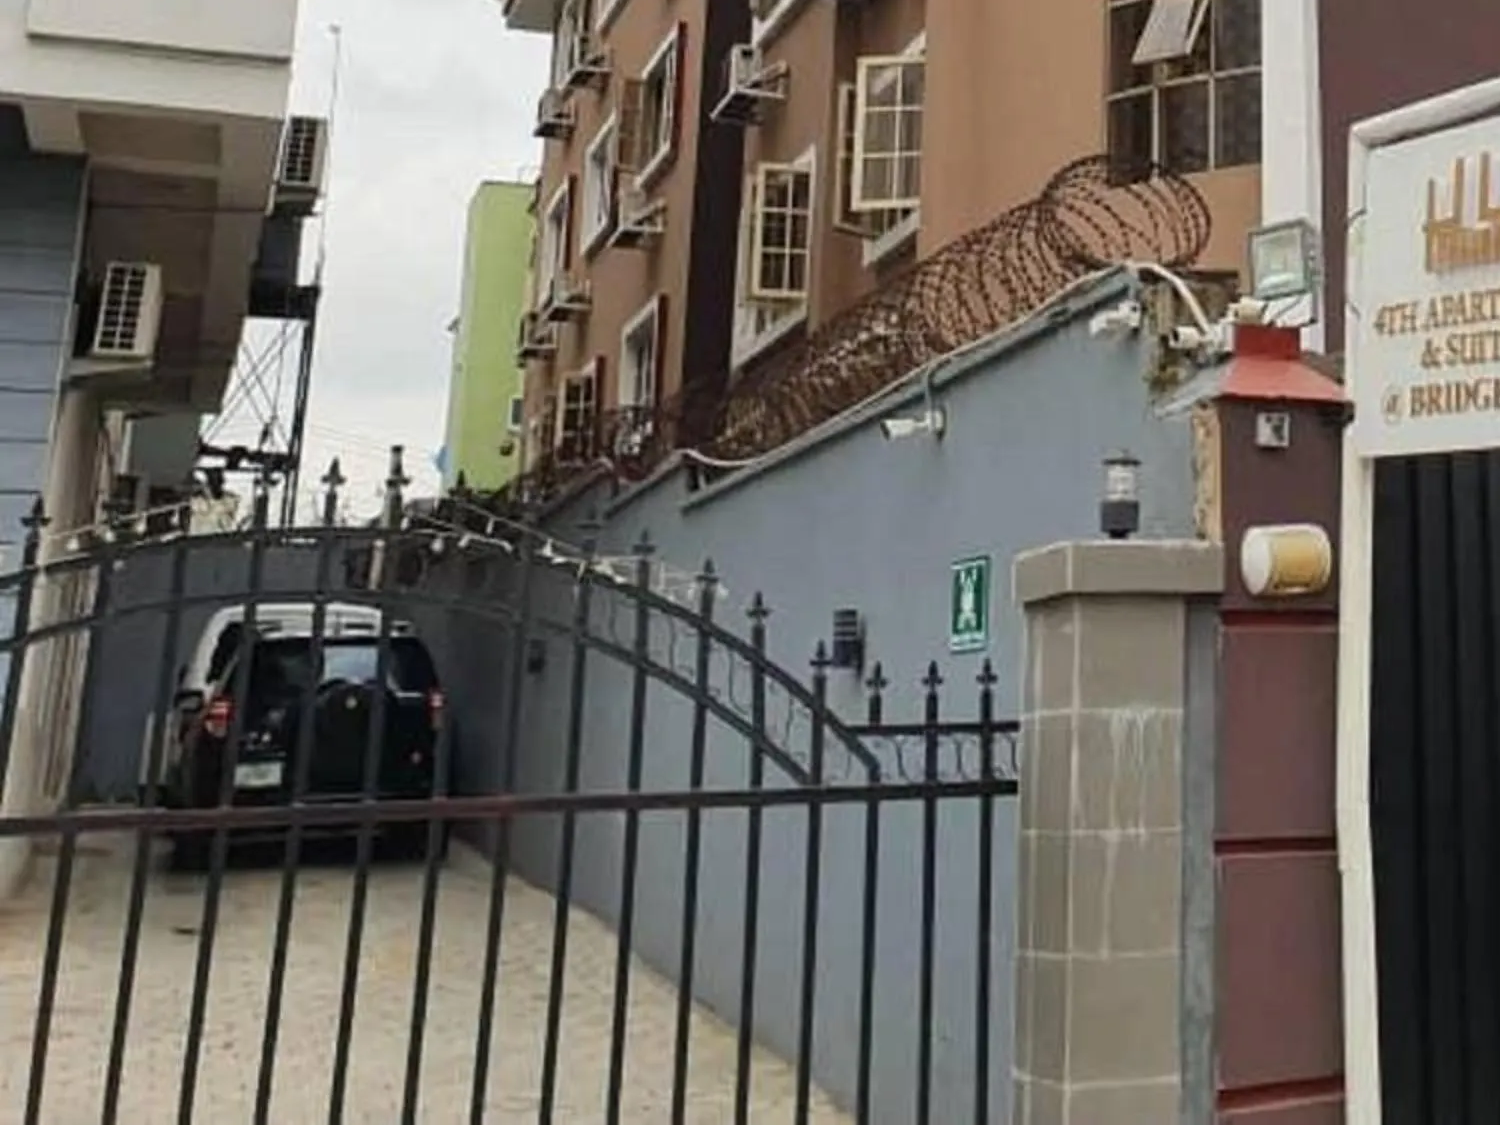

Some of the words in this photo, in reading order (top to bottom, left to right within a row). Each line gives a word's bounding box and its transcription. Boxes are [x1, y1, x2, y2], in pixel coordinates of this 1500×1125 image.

[1373, 301, 1419, 336] 4TH
[1420, 338, 1442, 369] &
[1380, 382, 1404, 424] @
